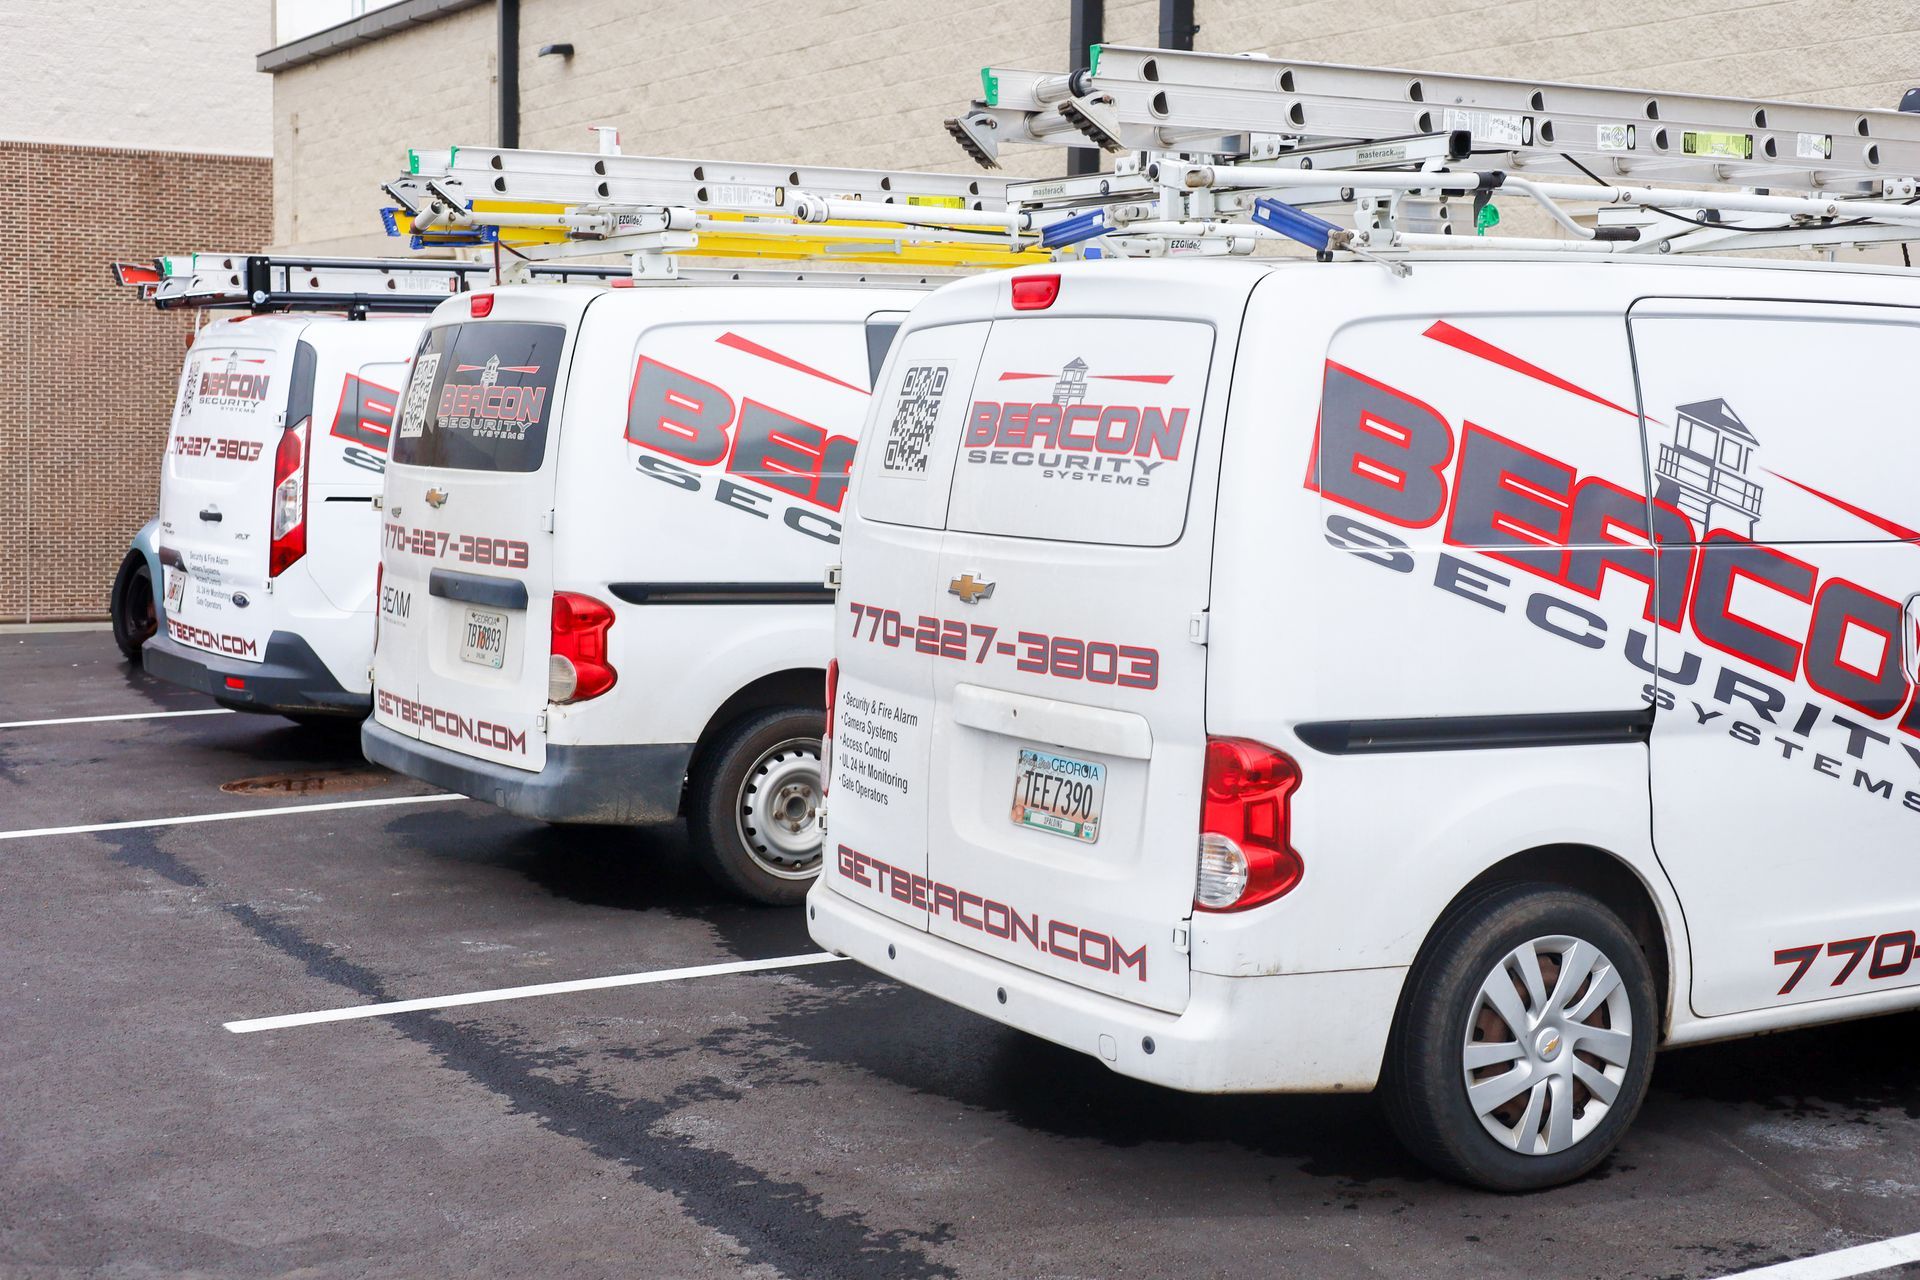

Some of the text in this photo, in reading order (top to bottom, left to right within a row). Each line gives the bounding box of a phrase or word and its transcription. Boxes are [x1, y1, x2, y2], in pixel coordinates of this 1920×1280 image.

[1358, 149, 1394, 159] masterack
[1170, 240, 1202, 250] EZGlide2
[199, 372, 270, 401] BEACON
[200, 397, 260, 408] SECURITY
[436, 384, 546, 423] BEACON
[438, 417, 532, 433] SECURITY
[472, 430, 525, 440] SYSTEMS
[964, 401, 1190, 461] BEACON
[968, 450, 1165, 476] SECURITY
[1043, 470, 1150, 486] SYSTEMS
[385, 523, 528, 569] 770-227-3803
[1304, 358, 1920, 739] BEACO
[383, 586, 410, 618] BEAM
[467, 623, 501, 652] TBT8893
[850, 602, 1160, 690] 770-227-3803
[378, 689, 526, 754] GETBEACON.COM
[846, 691, 918, 727] Security & Fire Alarm
[844, 712, 898, 743] Camera Systems
[842, 732, 891, 762] Access Control
[842, 752, 908, 794] UL 24 Hr Monitoring
[1052, 758, 1098, 780] GEORGIA
[842, 774, 889, 806] Gate Operators
[1024, 770, 1093, 820] TEE7390
[838, 844, 1147, 982] GETBEACON.COM
